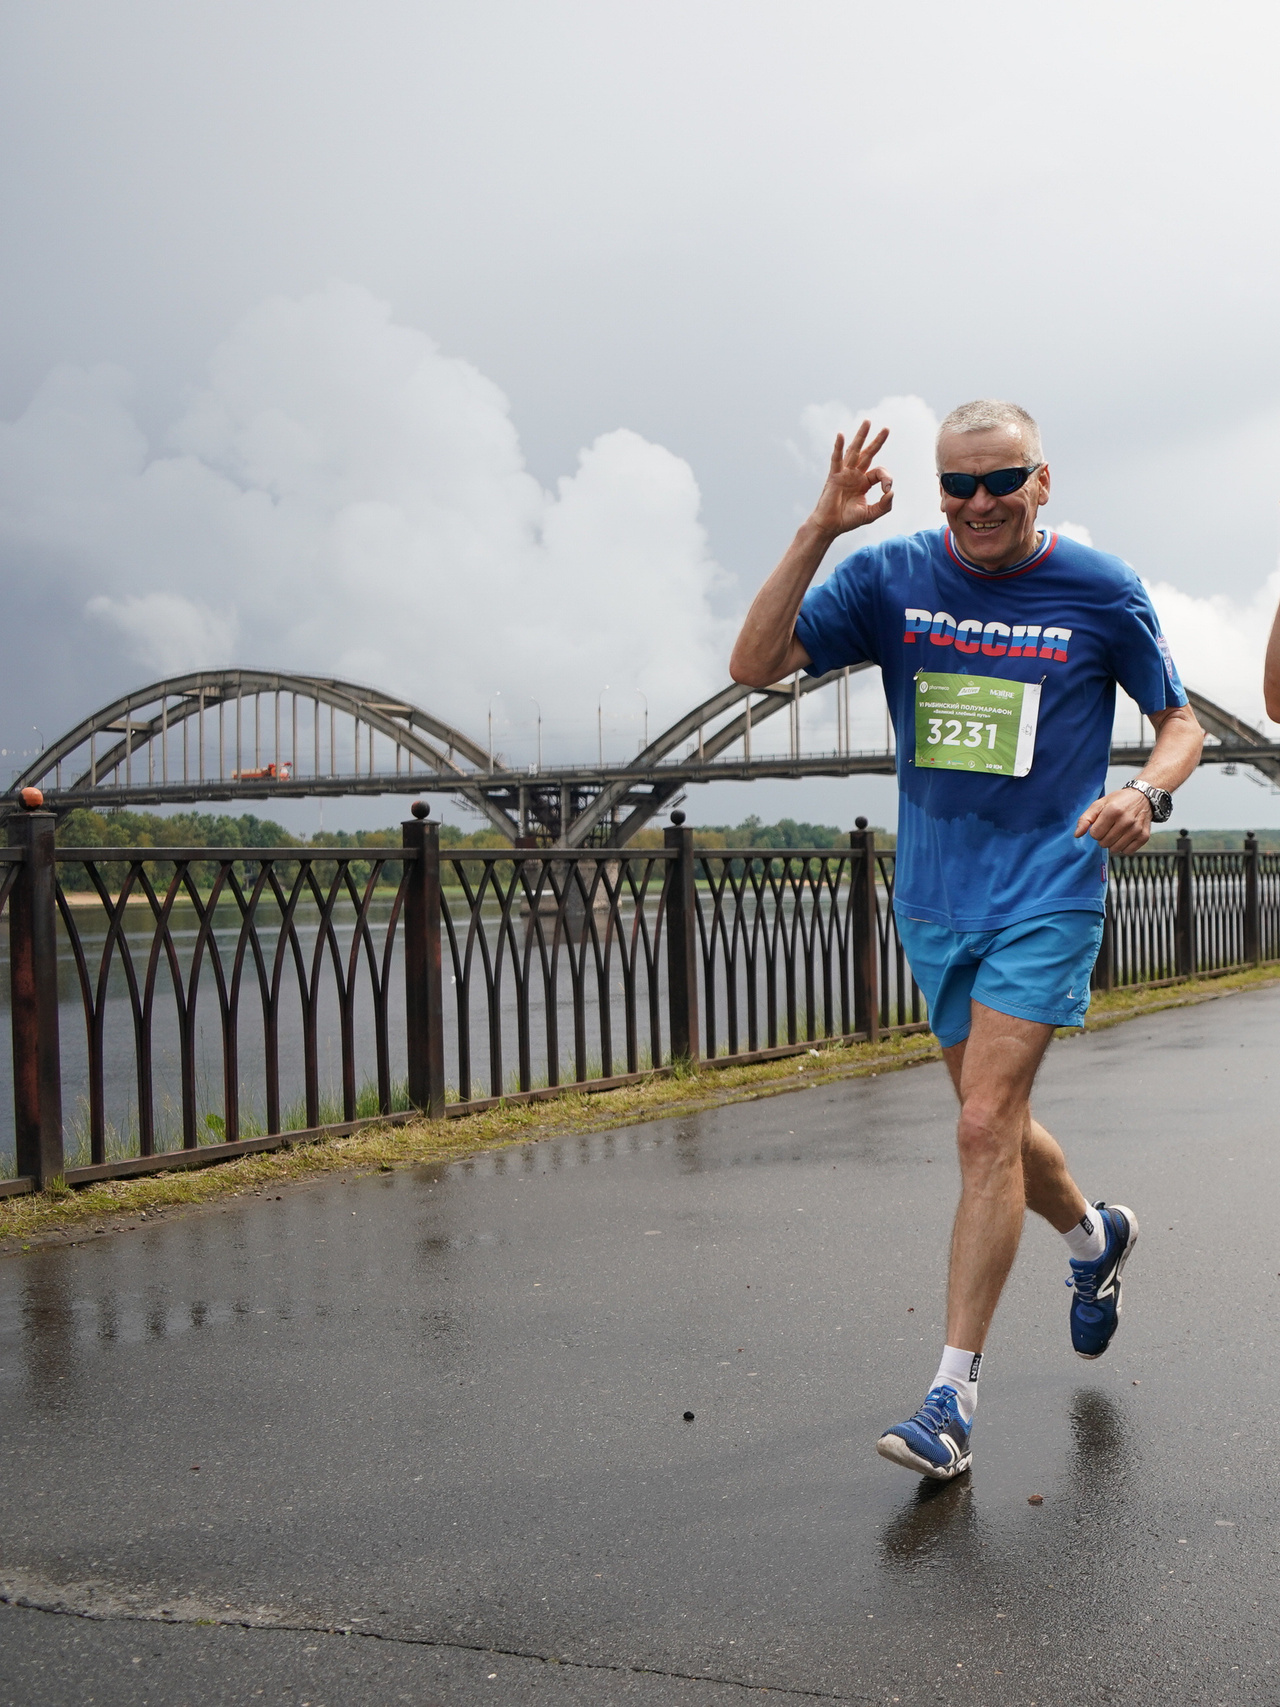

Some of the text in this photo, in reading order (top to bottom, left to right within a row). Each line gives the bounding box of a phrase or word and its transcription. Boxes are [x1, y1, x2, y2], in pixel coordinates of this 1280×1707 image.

[903, 607, 1073, 663] РОССИЯ
[925, 702, 960, 710] РЫБИНСКИЙ
[961, 704, 1012, 716] ПОЛУМАРАФОН
[926, 718, 998, 749] 3231
